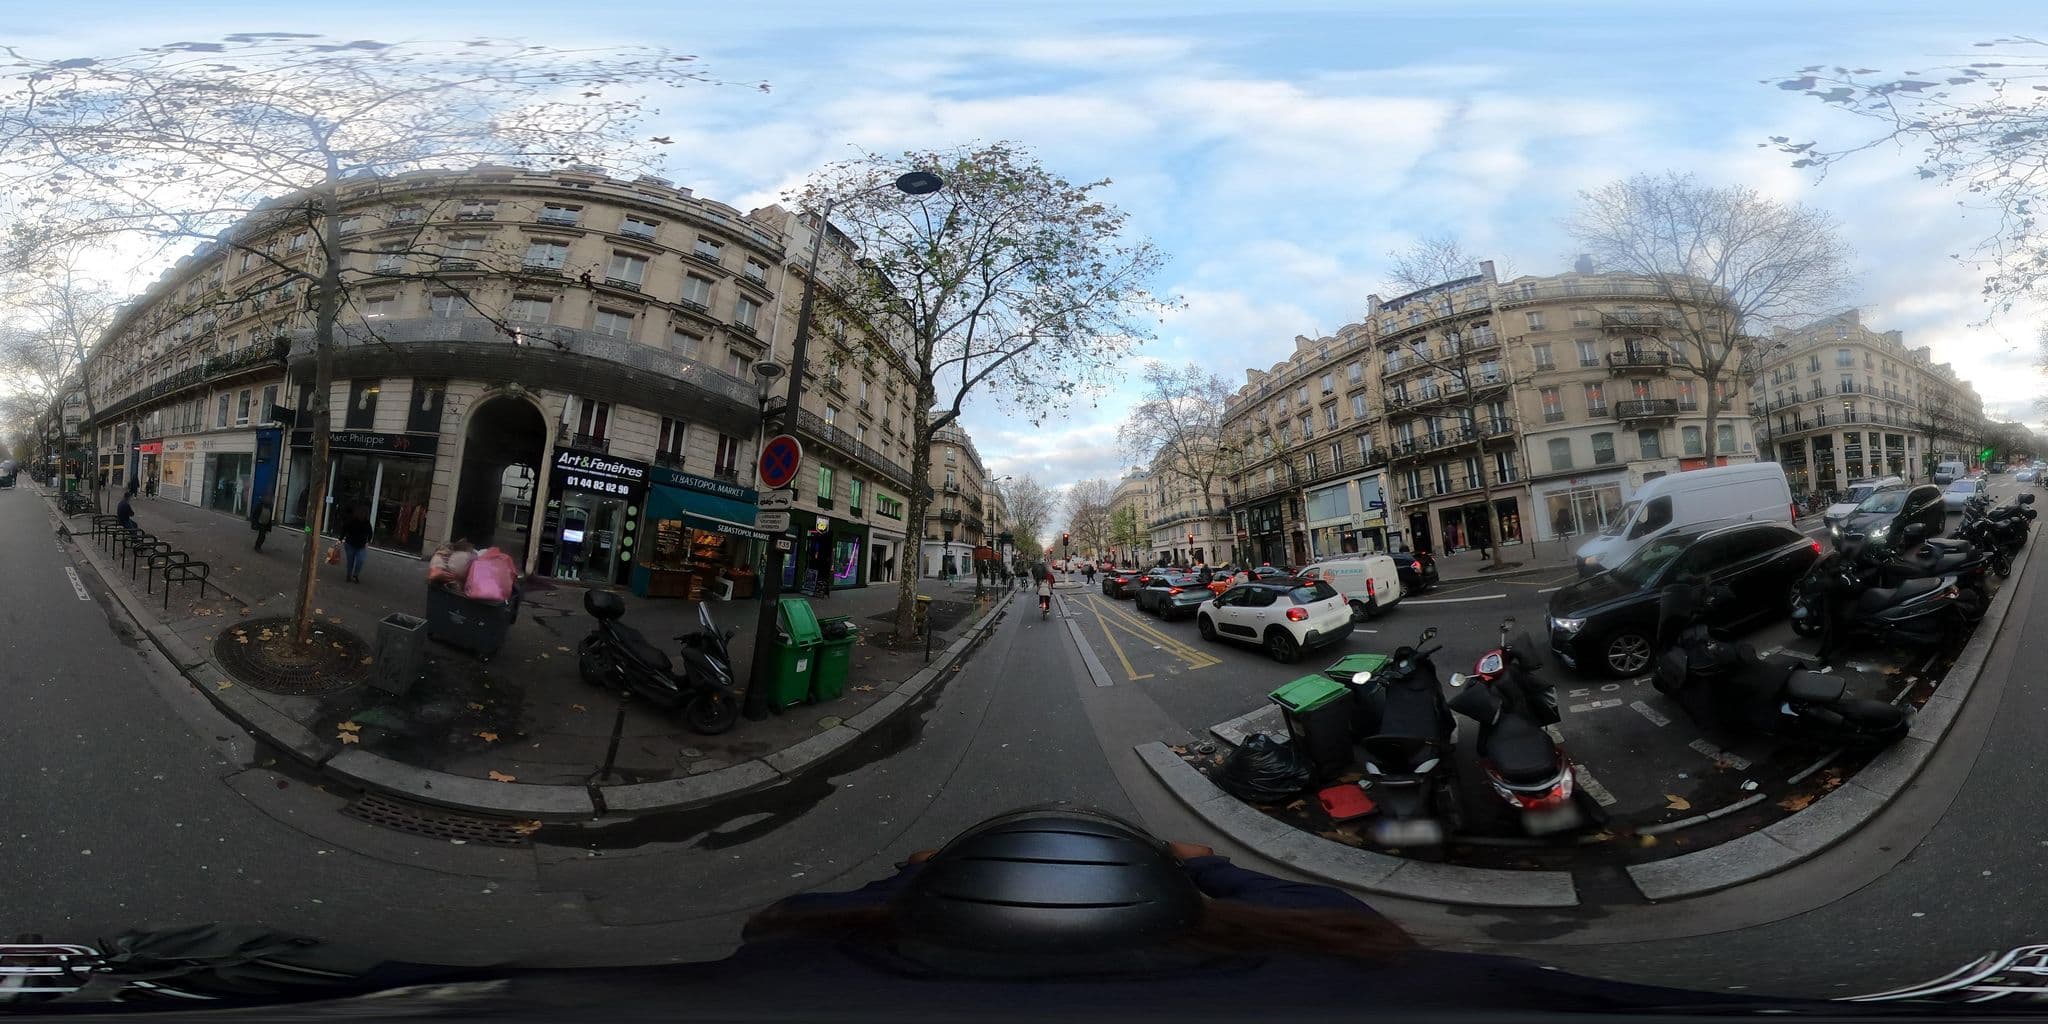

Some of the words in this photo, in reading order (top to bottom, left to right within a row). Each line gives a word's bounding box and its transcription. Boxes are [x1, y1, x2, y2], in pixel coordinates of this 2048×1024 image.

[349, 433, 385, 448] Philippe
[558, 452, 643, 477] Art&Fenêtres
[567, 476, 579, 486] 01
[580, 478, 592, 488] 44
[593, 480, 605, 490] 82
[605, 482, 617, 492] 02
[671, 473, 717, 491] SEBASTOPOL
[717, 485, 744, 497] MARKET
